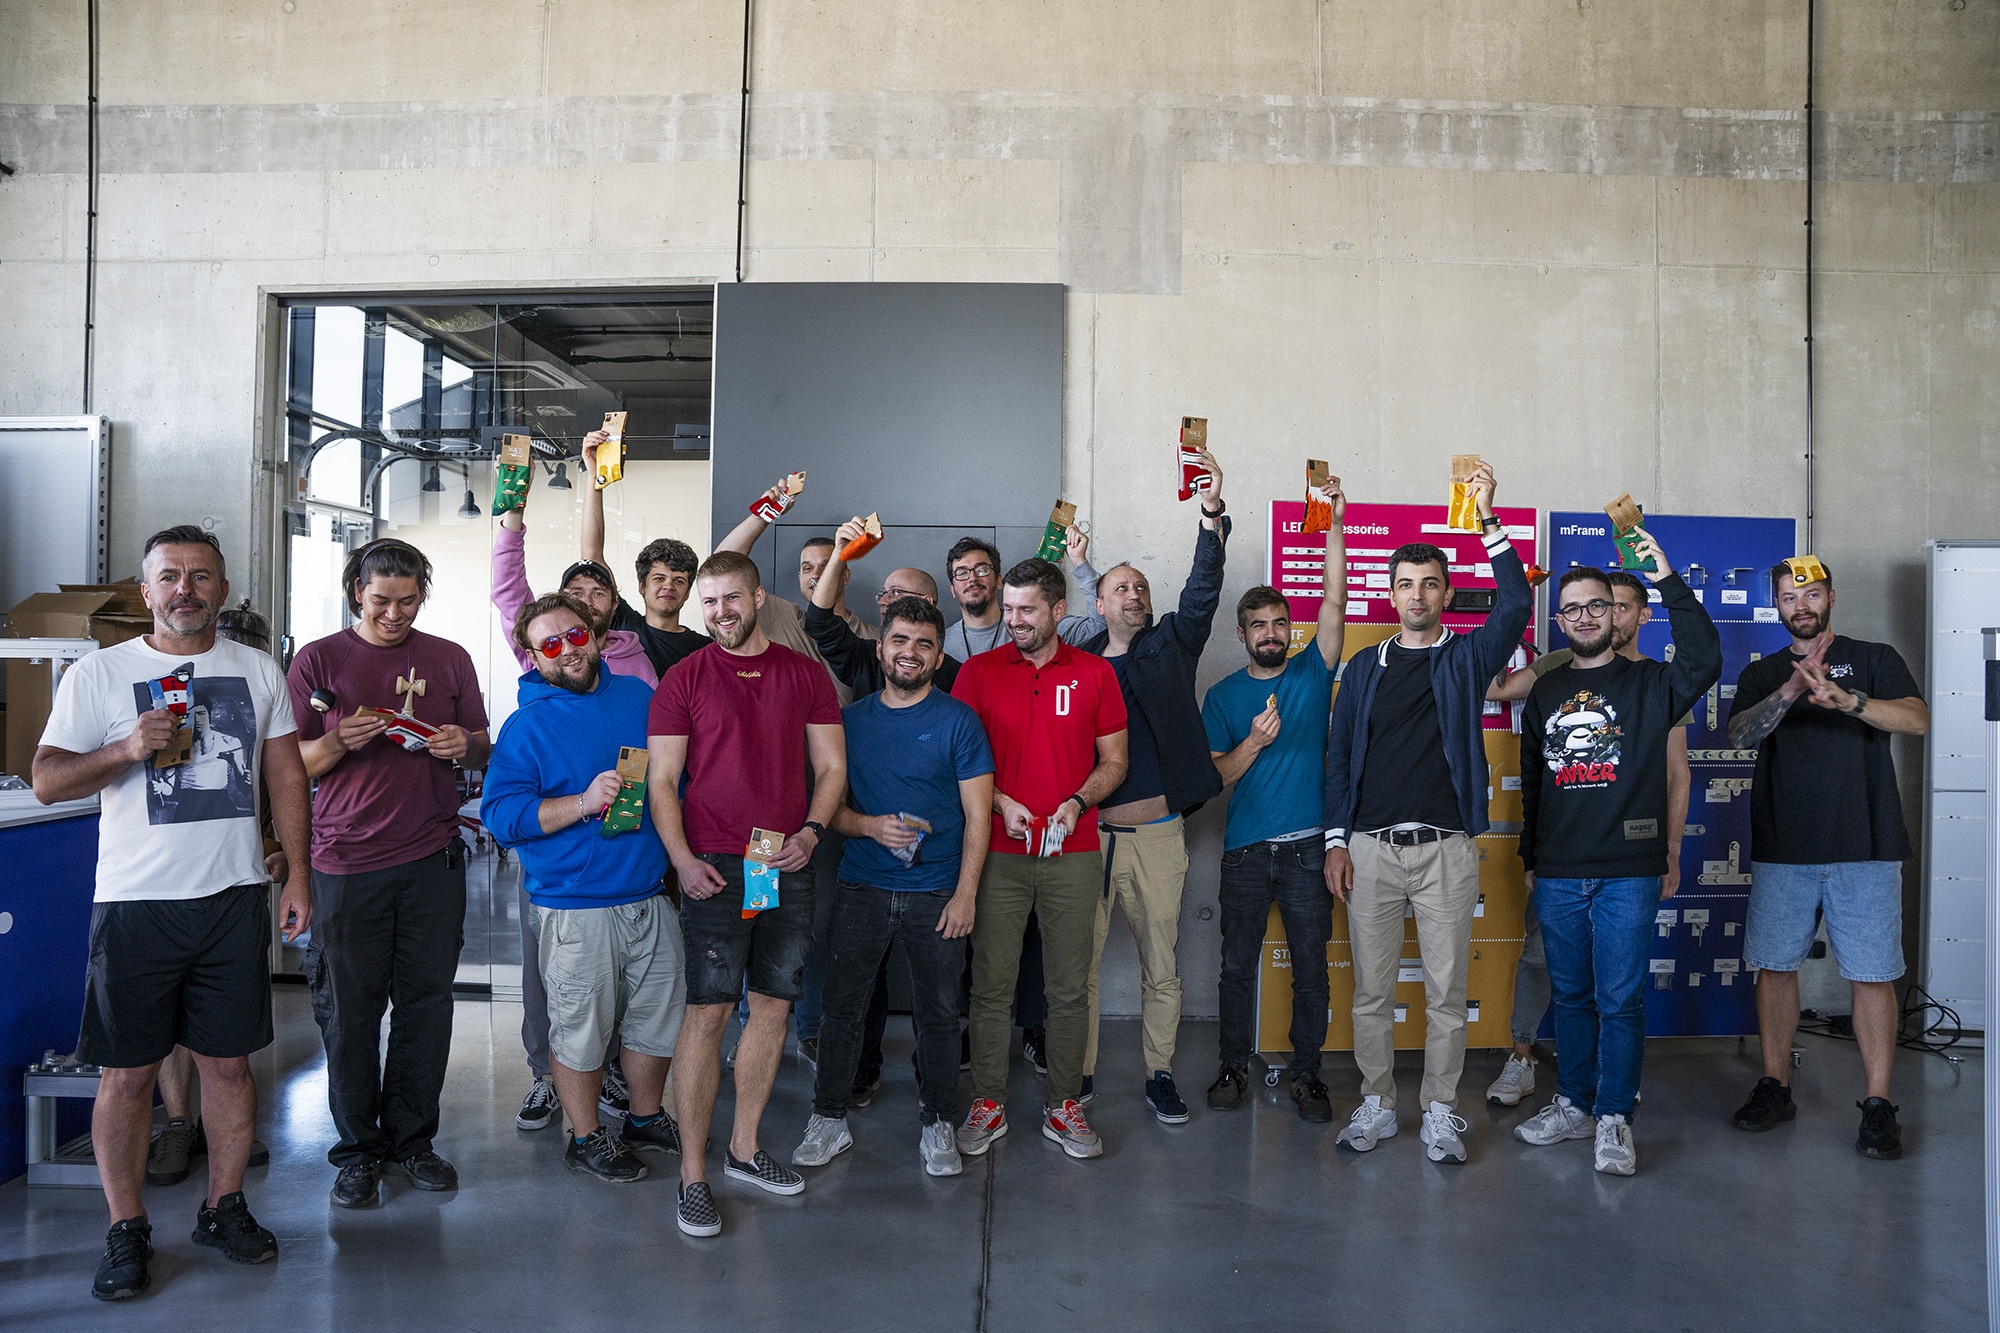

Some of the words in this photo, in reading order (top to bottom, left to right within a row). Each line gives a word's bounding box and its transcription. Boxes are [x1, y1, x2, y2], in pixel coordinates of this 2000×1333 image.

[1319, 523, 1390, 535] essories
[1560, 525, 1605, 536] mFrame
[1334, 960, 1351, 968] Light
